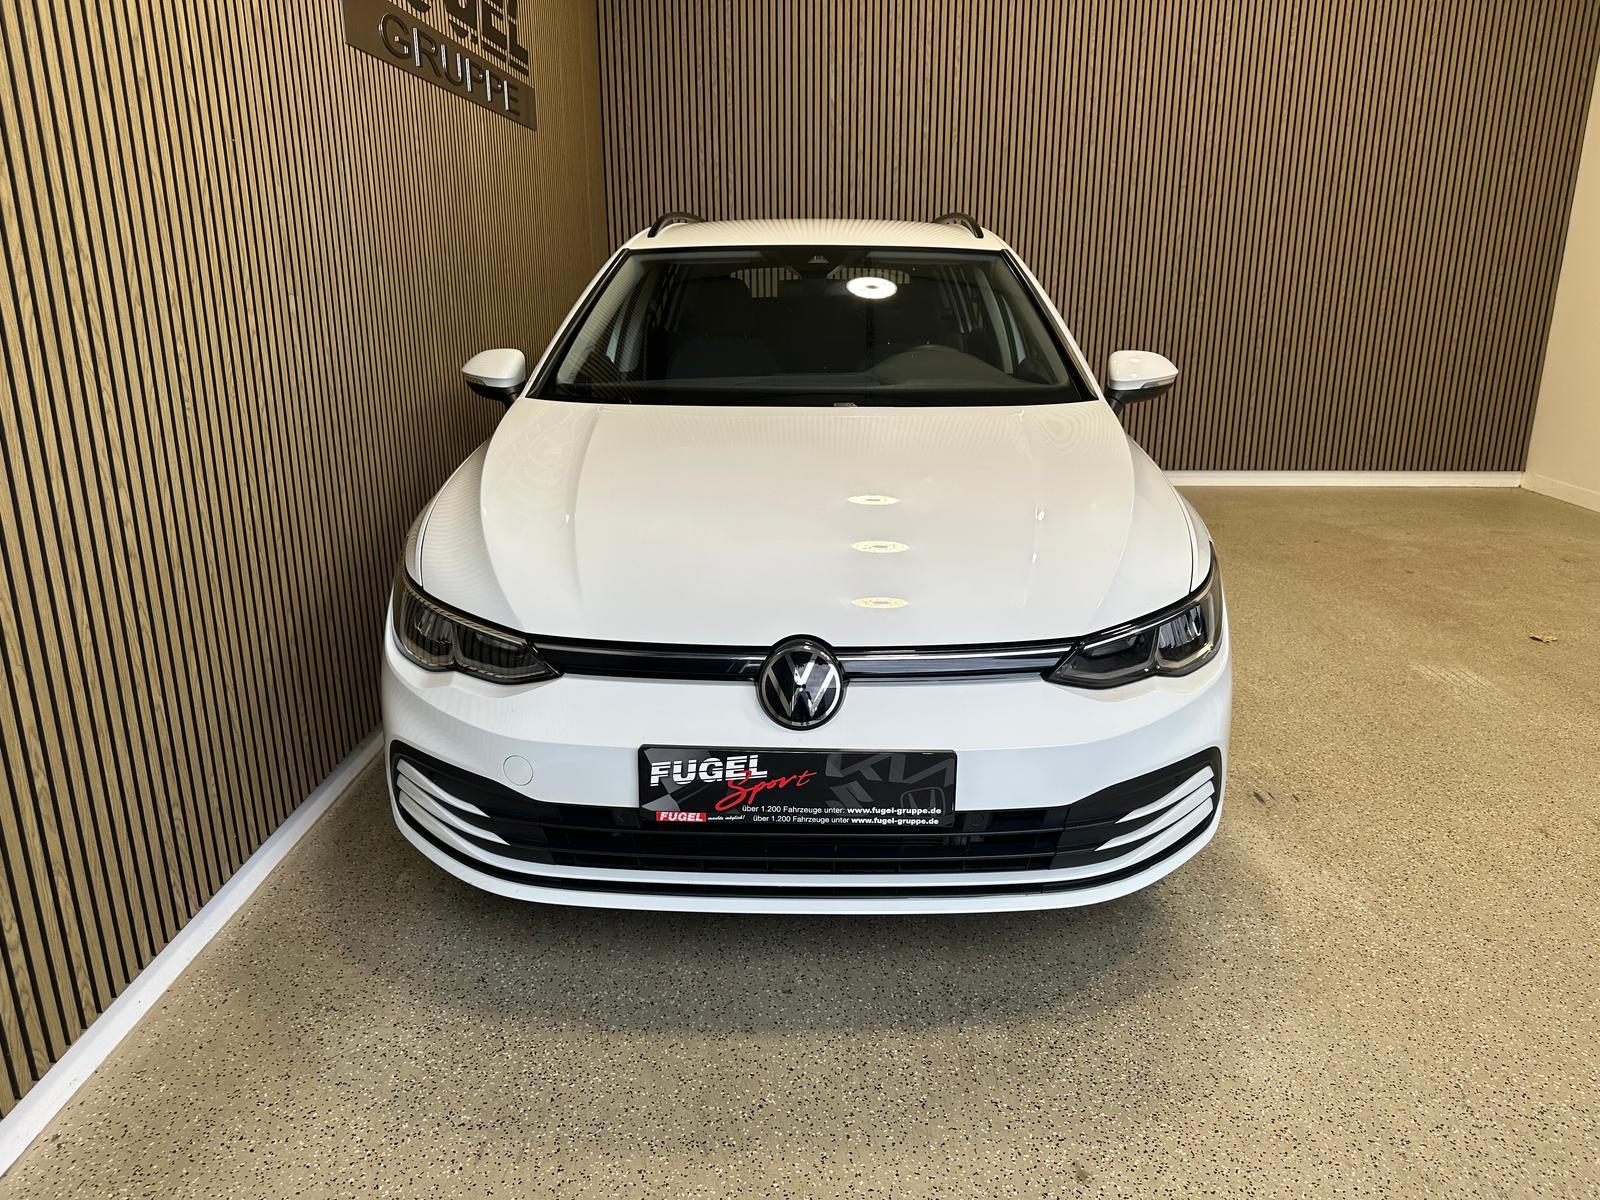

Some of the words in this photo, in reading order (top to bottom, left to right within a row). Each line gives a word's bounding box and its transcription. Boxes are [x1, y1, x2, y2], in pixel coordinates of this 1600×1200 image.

[378, 13, 521, 116] GRUPPE
[650, 755, 768, 787] FUGEL
[714, 769, 817, 811] Sport
[660, 812, 703, 822] FUGEL
[771, 815, 791, 823] 1.200
[792, 816, 830, 824] Fahrzeuge
[831, 816, 850, 824] unter
[851, 818, 939, 826] www.fugel-gruppe.de
[783, 806, 822, 814] Fahrzeuge
[824, 806, 845, 814] unter:
[847, 807, 942, 815] www.fugel-gruppe.de
